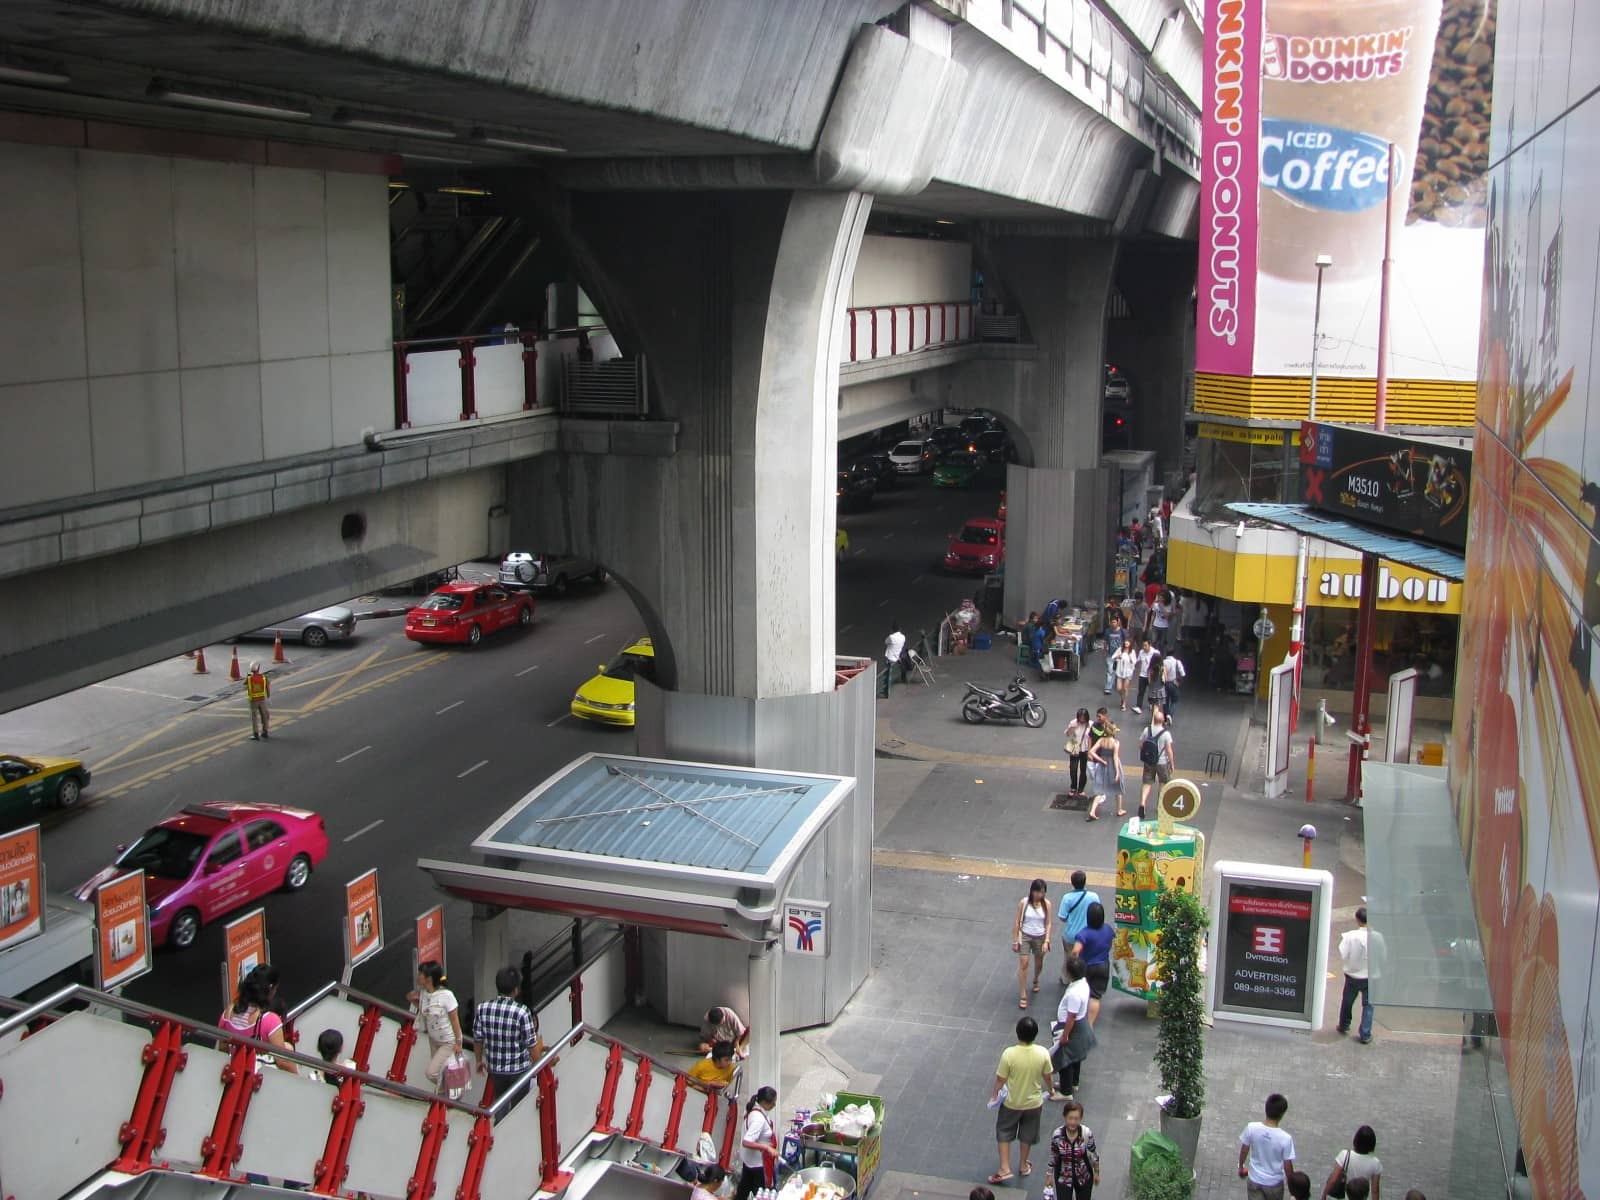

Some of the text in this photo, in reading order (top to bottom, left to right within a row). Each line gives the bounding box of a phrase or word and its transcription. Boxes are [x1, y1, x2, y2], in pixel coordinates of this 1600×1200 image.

[1289, 28, 1410, 60] DUNKIN'
[1289, 52, 1404, 82] DONUTS
[1286, 131, 1332, 148] ICED
[1260, 136, 1391, 191] Coffee
[1347, 475, 1379, 498] M3510
[1319, 566, 1448, 602] au bon
[1171, 794, 1185, 811] 4
[789, 908, 822, 918] BTS
[1234, 969, 1297, 984] ADVERTISING
